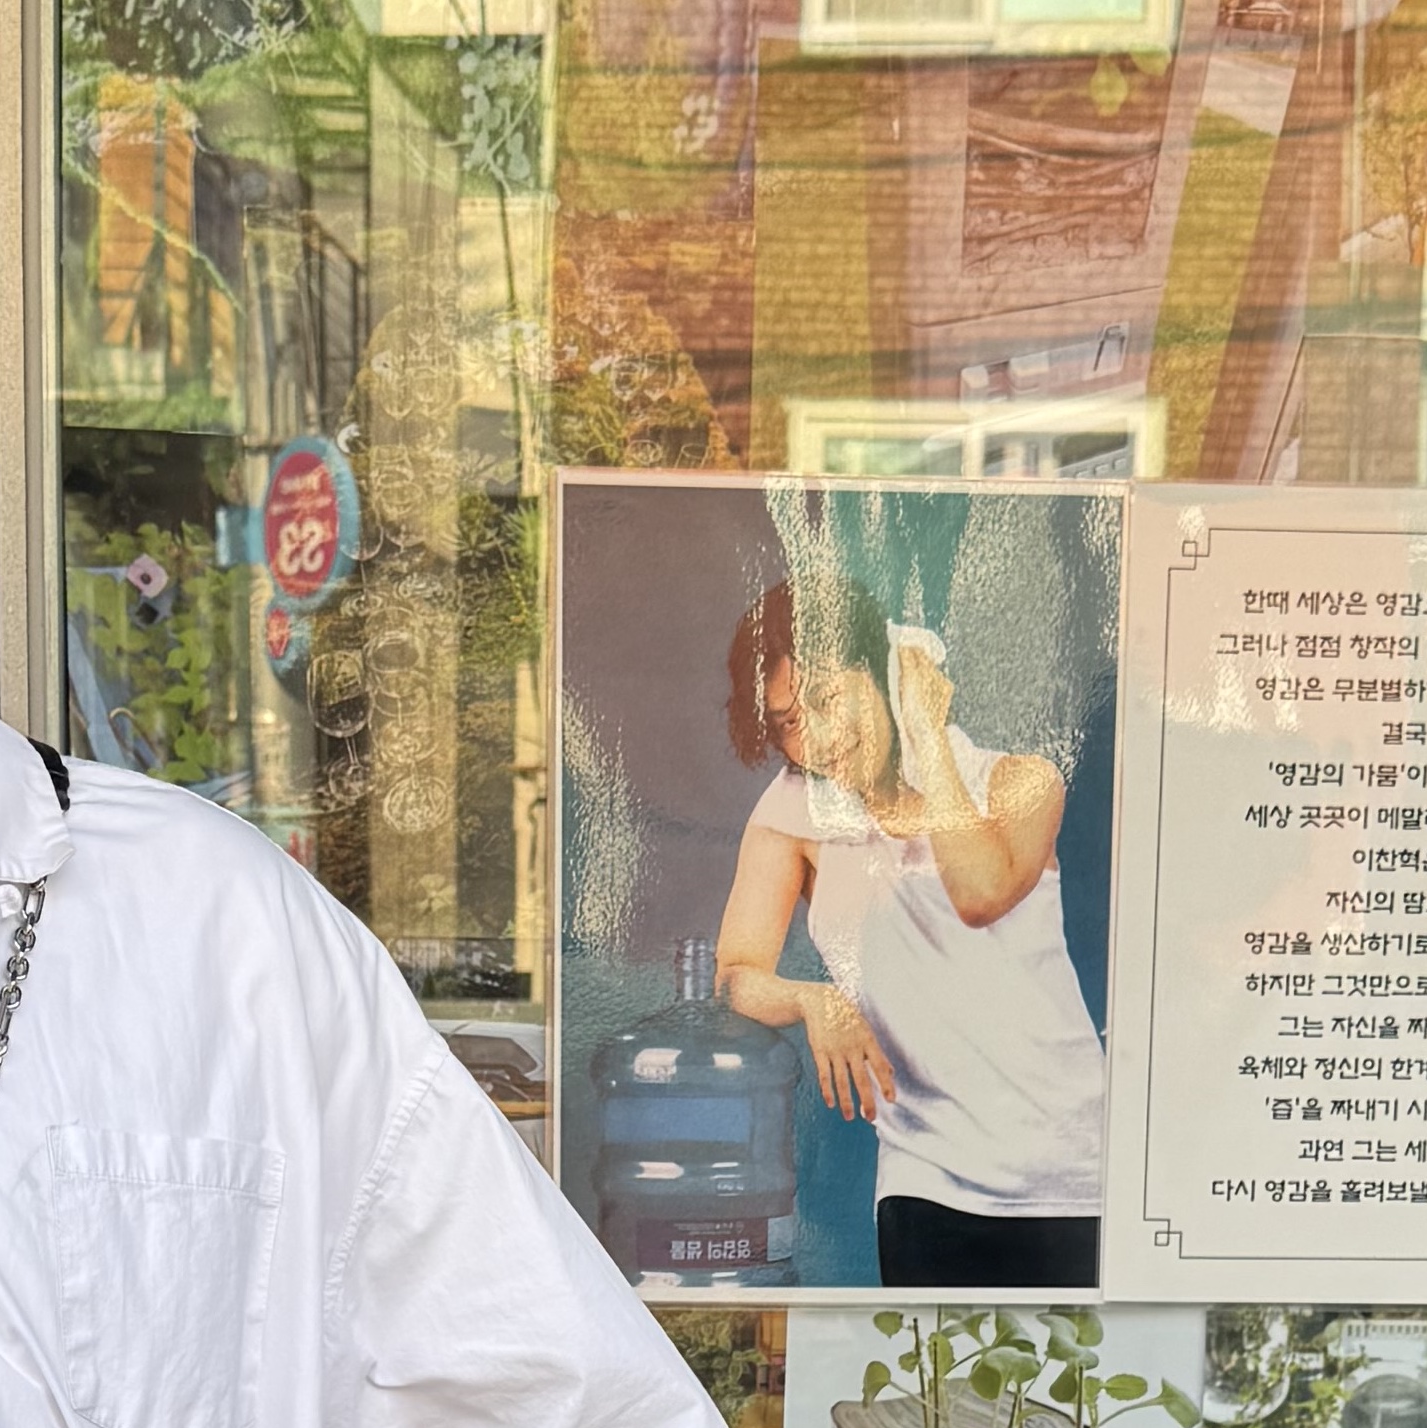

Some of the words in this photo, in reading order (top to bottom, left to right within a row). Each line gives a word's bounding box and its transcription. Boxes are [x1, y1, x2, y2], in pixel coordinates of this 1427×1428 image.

[1241, 587, 1291, 616] 한때
[1295, 590, 1369, 617] 세상은
[1215, 632, 1289, 659] 그러나
[1294, 633, 1343, 660] 점점
[1348, 633, 1421, 661] 창작의
[1254, 674, 1326, 702] 영감은
[1243, 803, 1295, 830] 세상
[1298, 804, 1370, 831] 곳곳이
[1325, 889, 1397, 916] 자신의
[1243, 929, 1314, 957] 영감을
[1244, 972, 1317, 998] 하지만
[1276, 1014, 1325, 1039] 그는
[1330, 1014, 1401, 1041] 자신을
[1313, 1055, 1384, 1082] 정신의
[1329, 1096, 1400, 1123] 짜내기
[1297, 1137, 1345, 1164] 과연
[1350, 1138, 1399, 1164] 그는
[1210, 1178, 1257, 1203] 다시
[1263, 1178, 1334, 1204] 영감을
